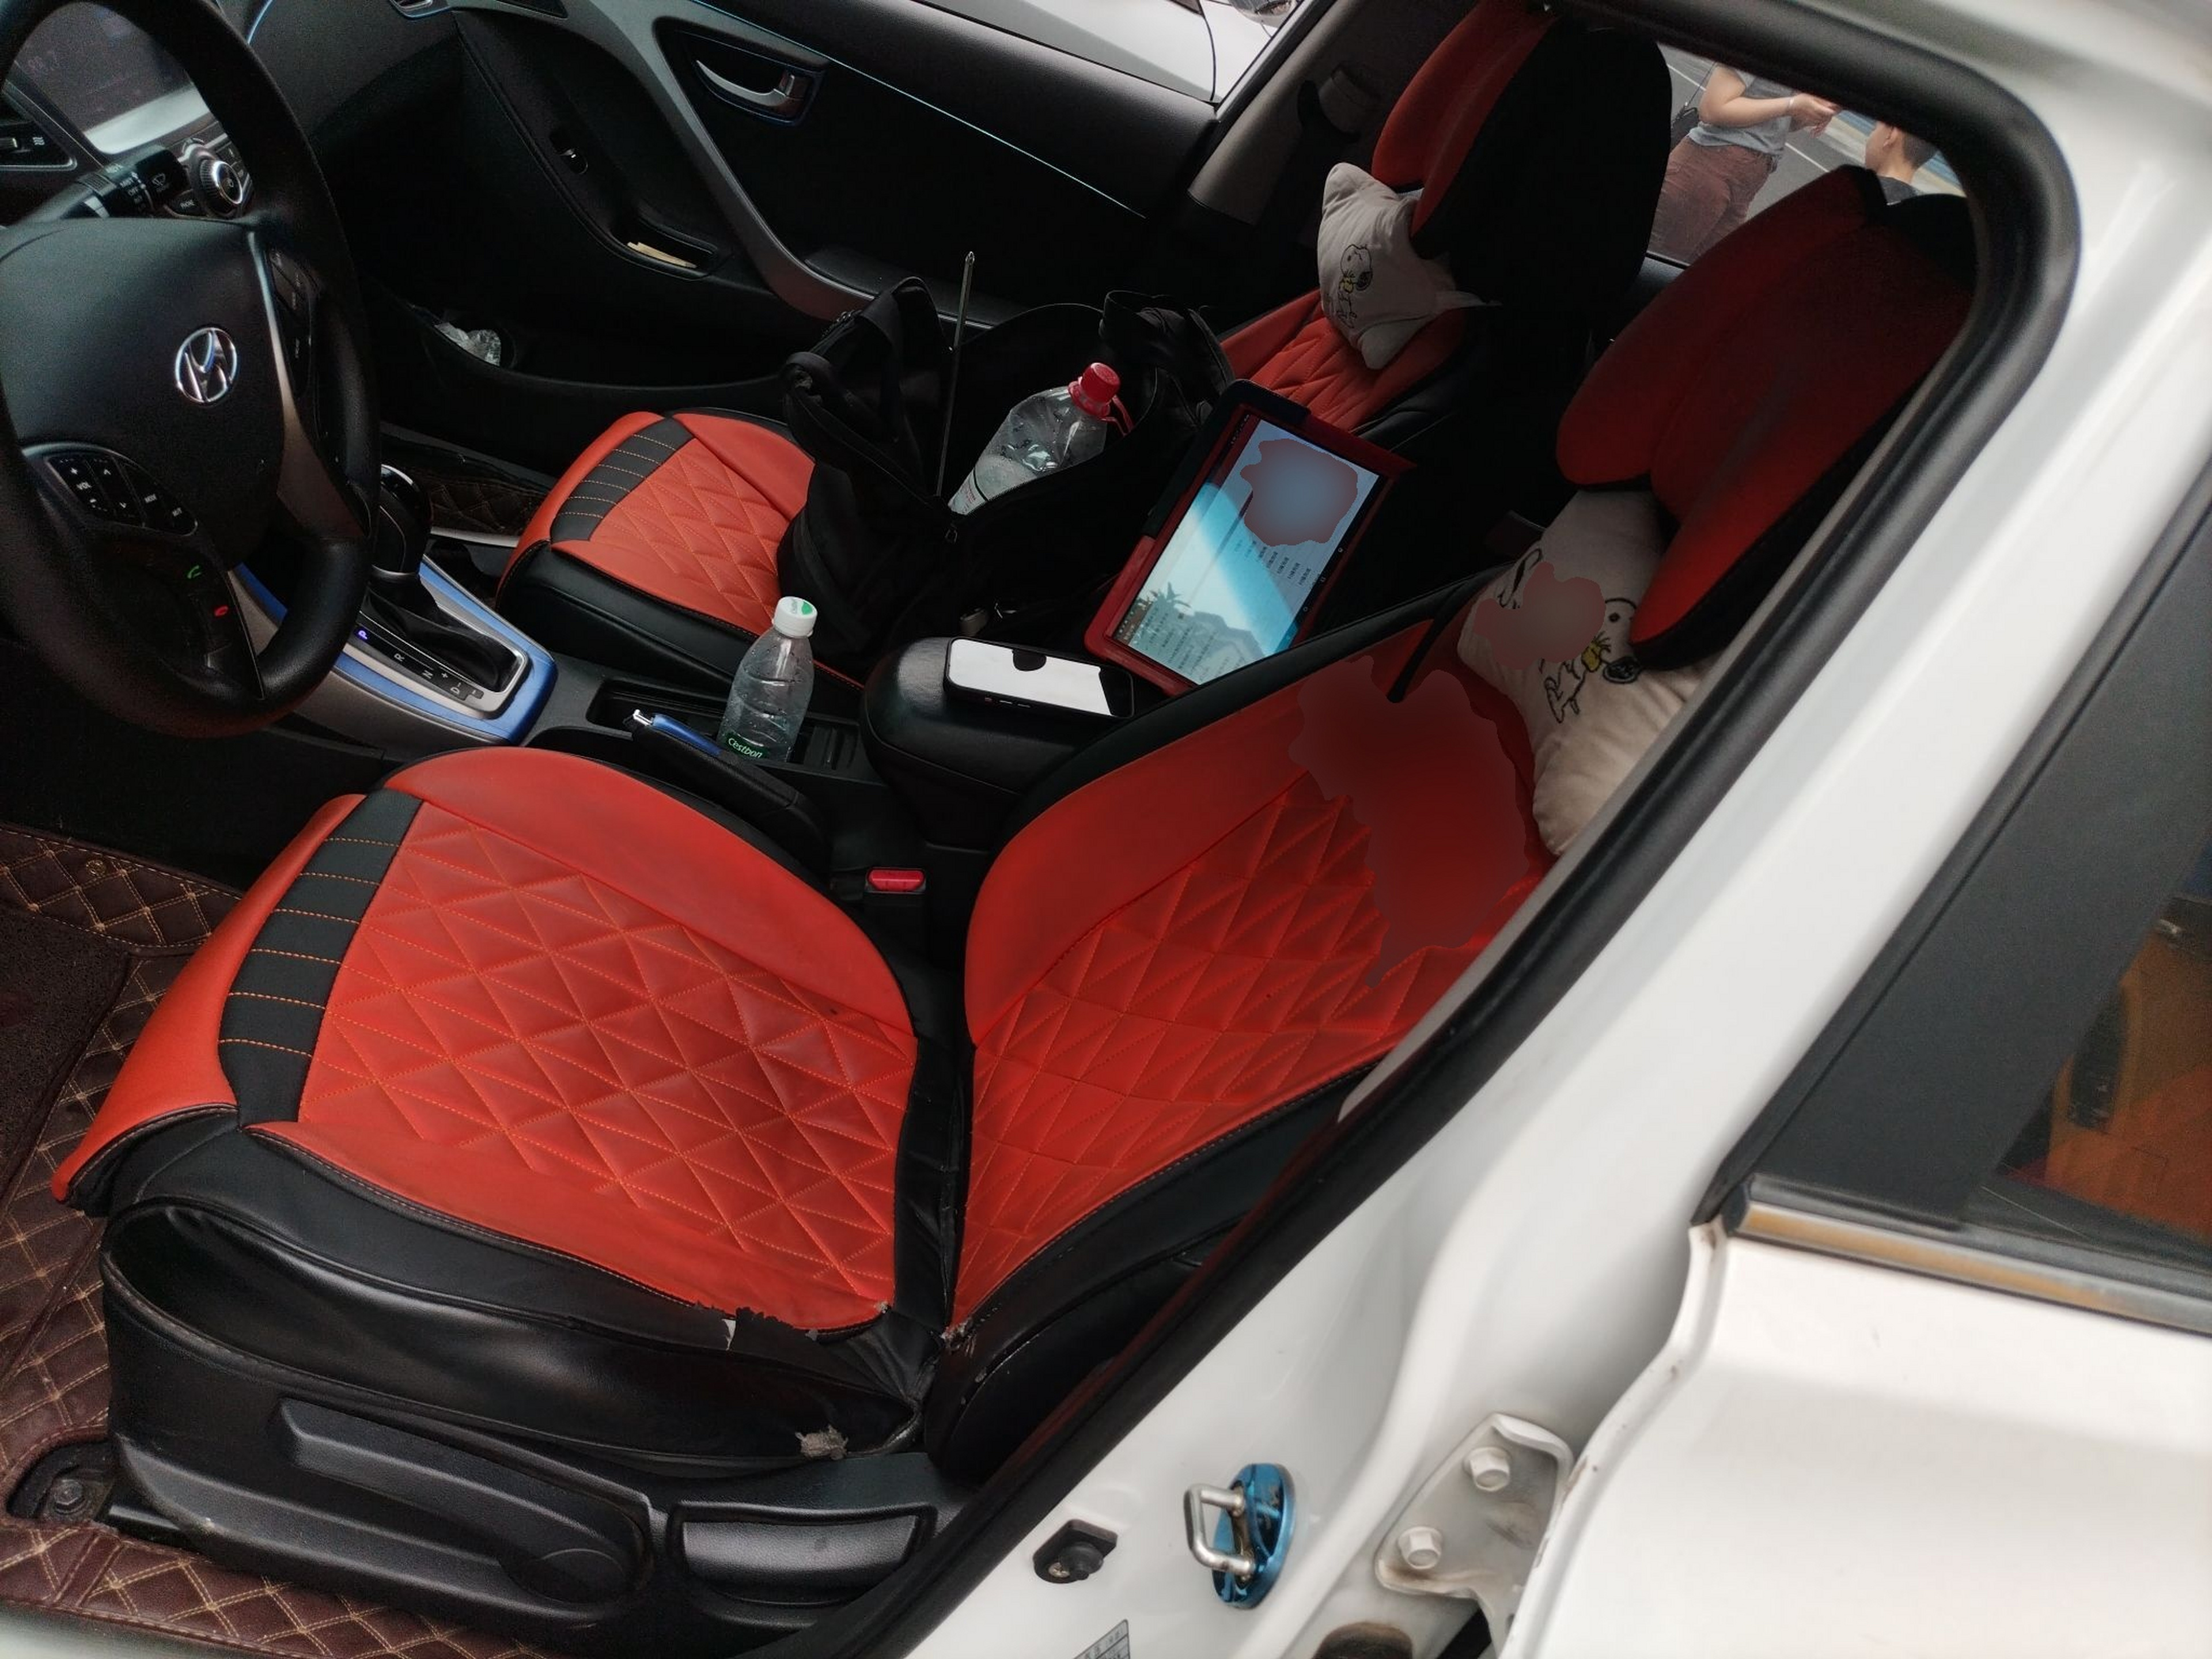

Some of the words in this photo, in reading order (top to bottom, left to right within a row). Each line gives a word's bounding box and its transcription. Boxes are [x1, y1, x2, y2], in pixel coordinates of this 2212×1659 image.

[77, 482, 91, 490] VOL
[358, 630, 368, 640] P
[394, 653, 405, 662] R
[422, 670, 434, 679] N
